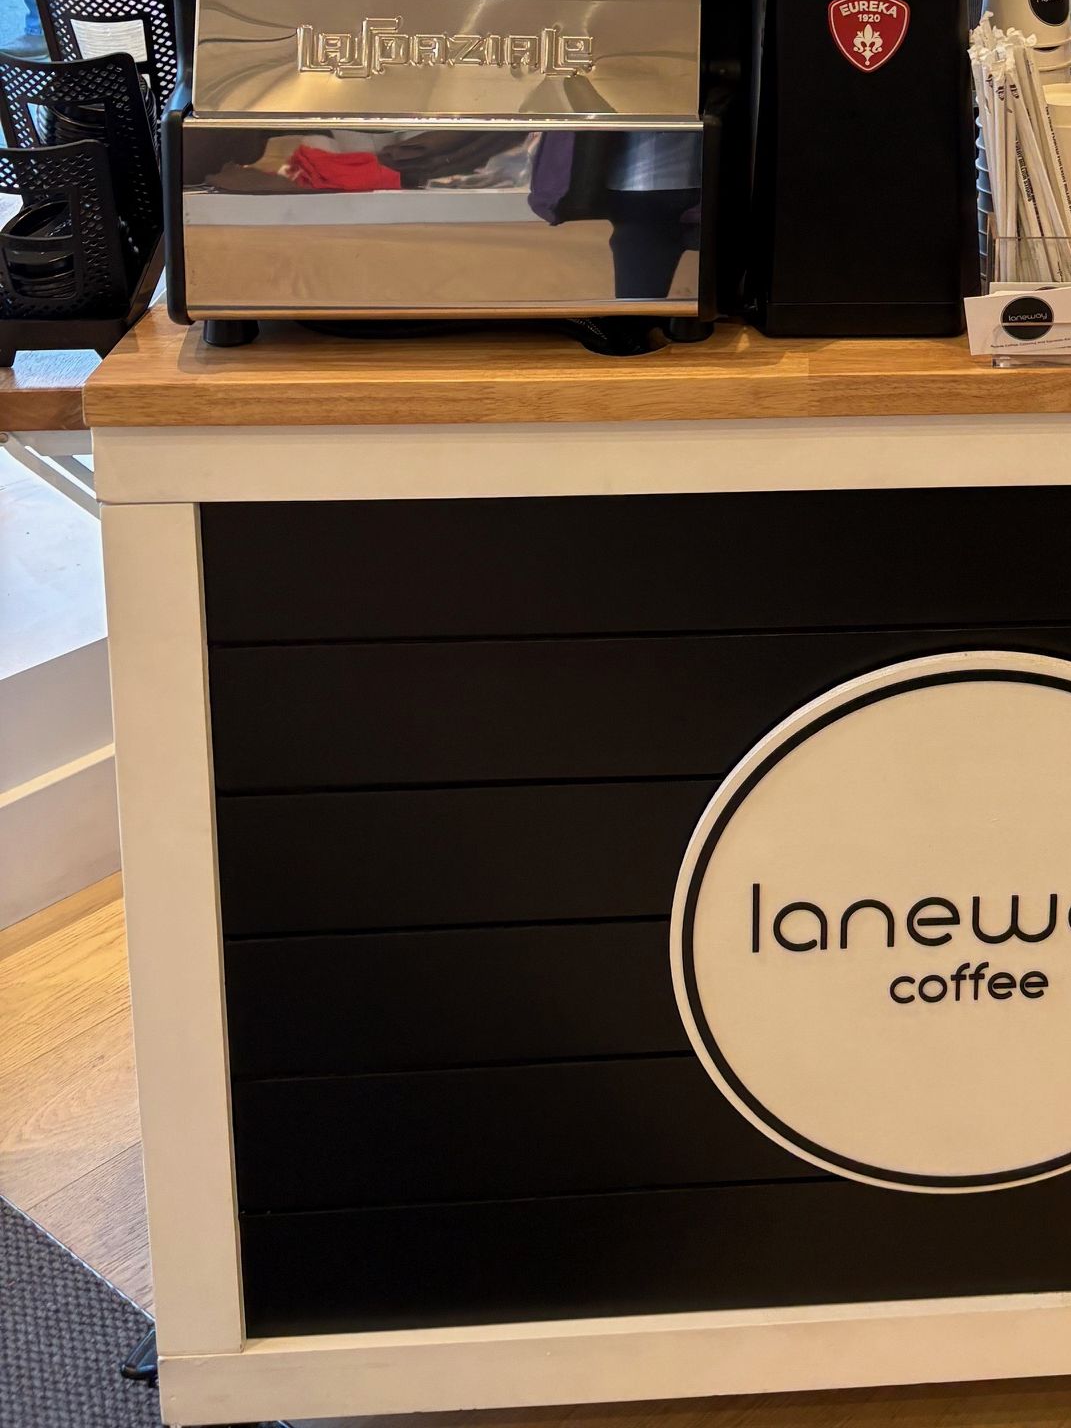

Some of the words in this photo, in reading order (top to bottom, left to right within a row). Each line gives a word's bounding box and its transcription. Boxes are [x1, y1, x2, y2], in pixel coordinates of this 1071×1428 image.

[839, 0, 897, 19] EUREKA
[857, 13, 881, 23] 1920
[1008, 312, 1048, 322] laneway
[889, 961, 1050, 1004] coffee
